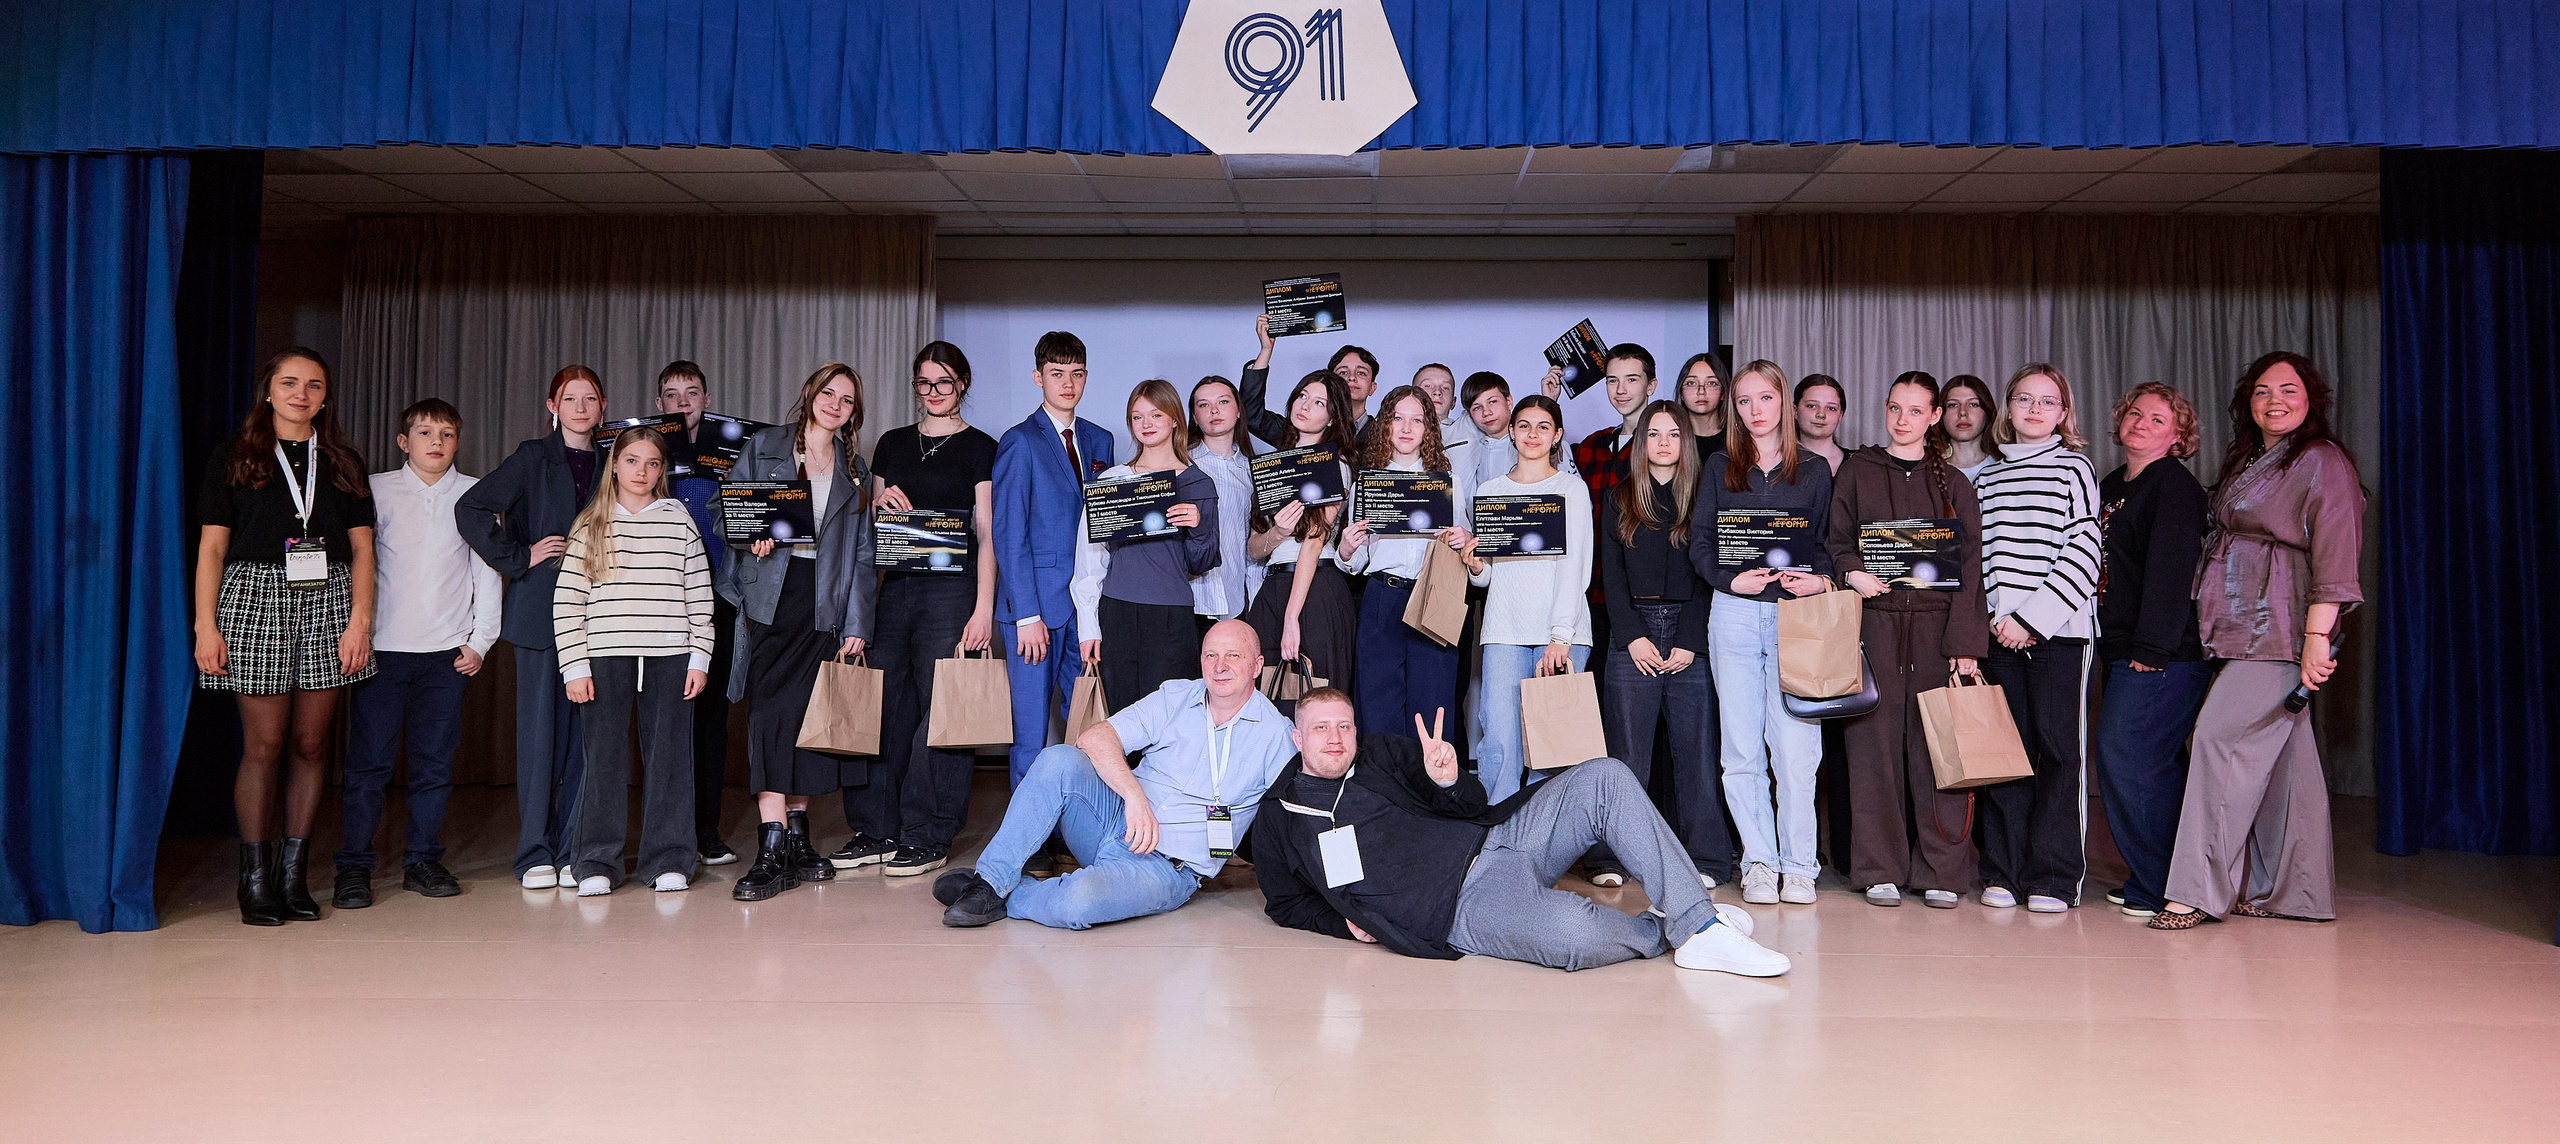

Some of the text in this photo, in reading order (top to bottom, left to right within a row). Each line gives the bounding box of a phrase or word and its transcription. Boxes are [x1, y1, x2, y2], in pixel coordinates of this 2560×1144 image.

[1225, 8, 1345, 133] 91
[1265, 286, 1292, 296] ДИПЛОМ
[1252, 458, 1282, 471] ДИПЛОМ
[1363, 480, 1395, 488] ДИПЛОМ
[721, 489, 753, 497] ДИПЛОМ
[1086, 485, 1118, 497] ДИПЛОМ
[1475, 504, 1507, 512] ДИПЛОМ
[877, 514, 909, 523] ДИПЛОМ
[1717, 516, 1751, 524] ДИПЛОМ
[1861, 529, 1895, 537] ДИПЛОМ
